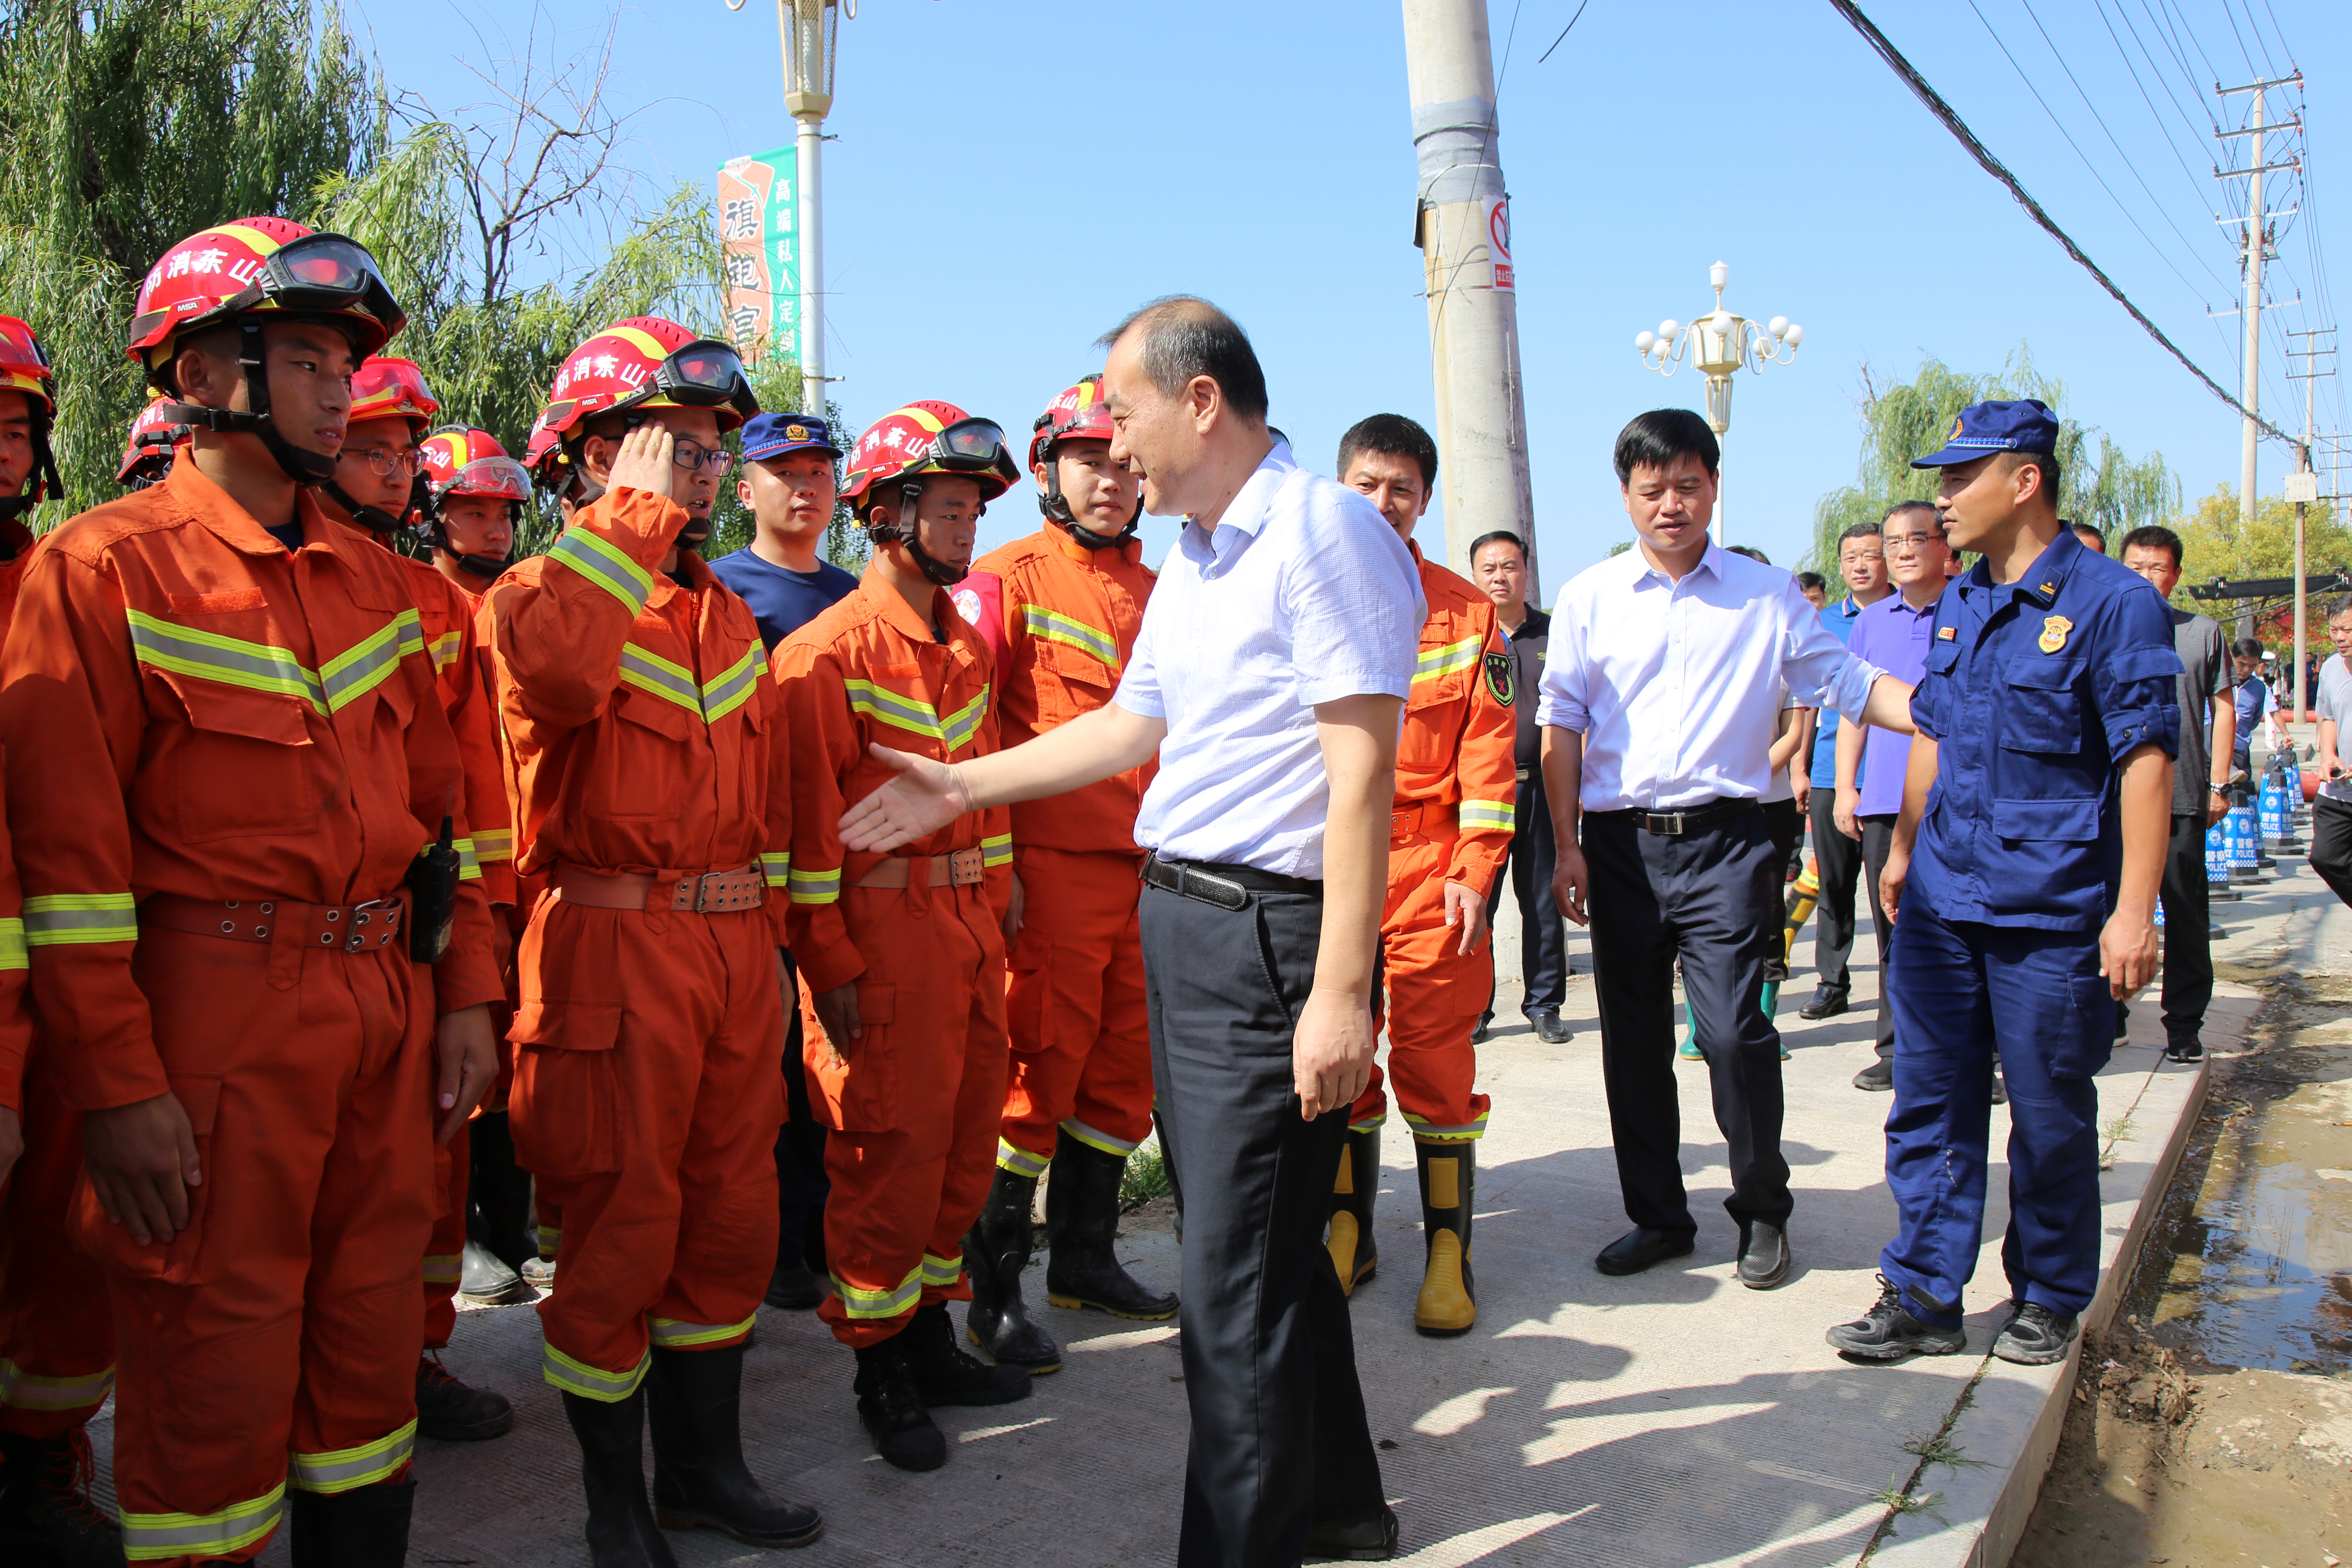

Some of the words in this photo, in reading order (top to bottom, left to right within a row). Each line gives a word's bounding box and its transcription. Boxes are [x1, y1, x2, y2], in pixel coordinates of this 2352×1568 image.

[775, 178, 795, 352] 高端私人定制
[177, 302, 198, 312] MSA
[1488, 658, 1506, 668] 总指挥
[2262, 812, 2280, 822] 警察
[2261, 822, 2279, 831] POLICE
[2236, 837, 2254, 849] 警察
[2205, 851, 2225, 862] 警察
[2236, 850, 2254, 858] POLICE
[2205, 863, 2227, 872] POLICE
